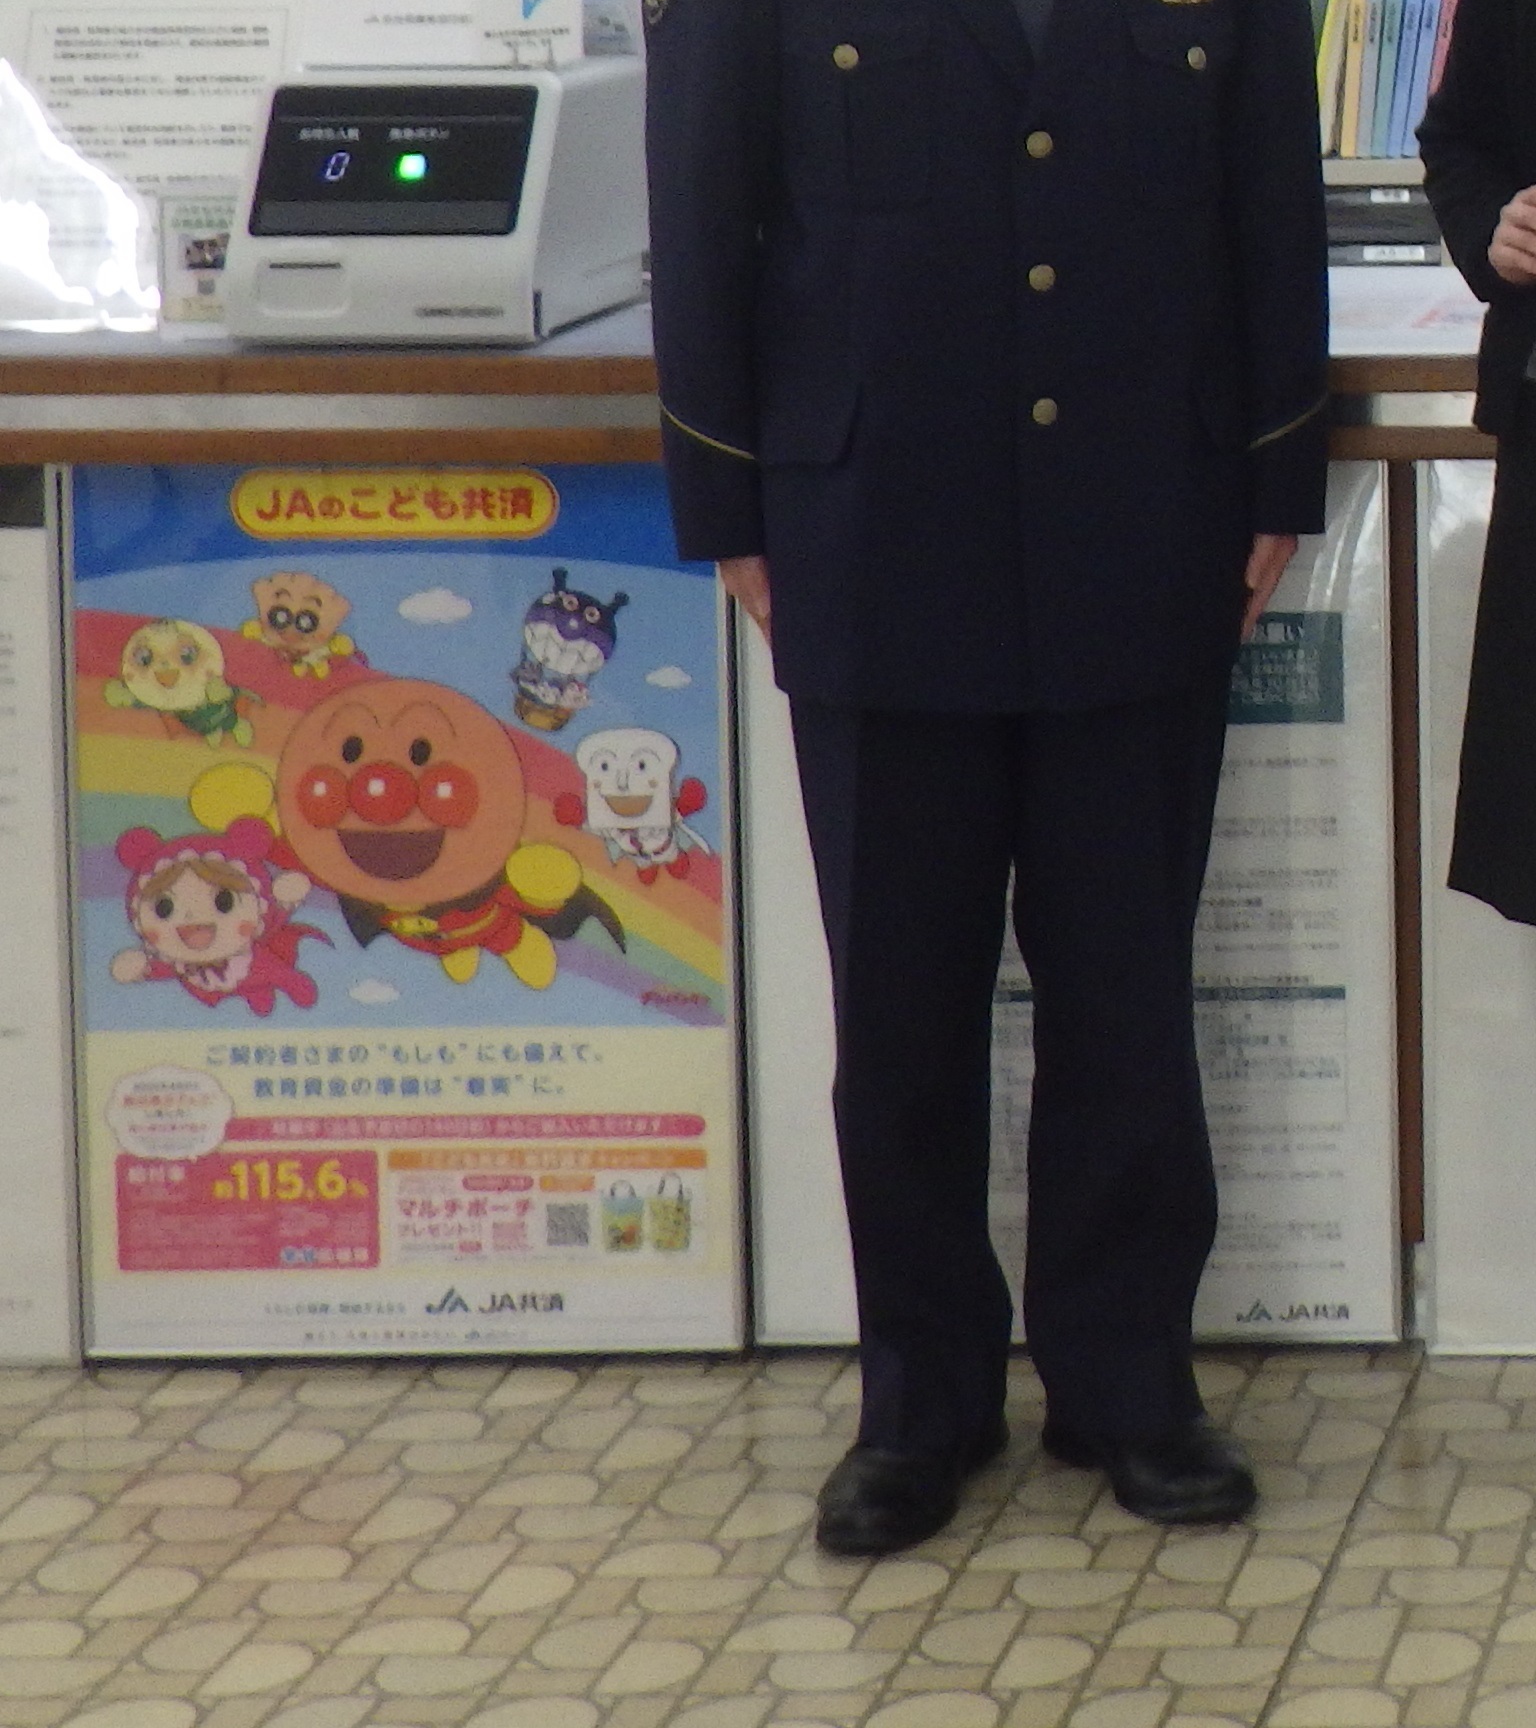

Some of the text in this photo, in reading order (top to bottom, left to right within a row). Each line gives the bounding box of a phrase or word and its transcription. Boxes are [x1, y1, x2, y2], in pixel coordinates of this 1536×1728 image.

[324, 151, 351, 182] 0
[255, 486, 534, 522] JAのこども共済
